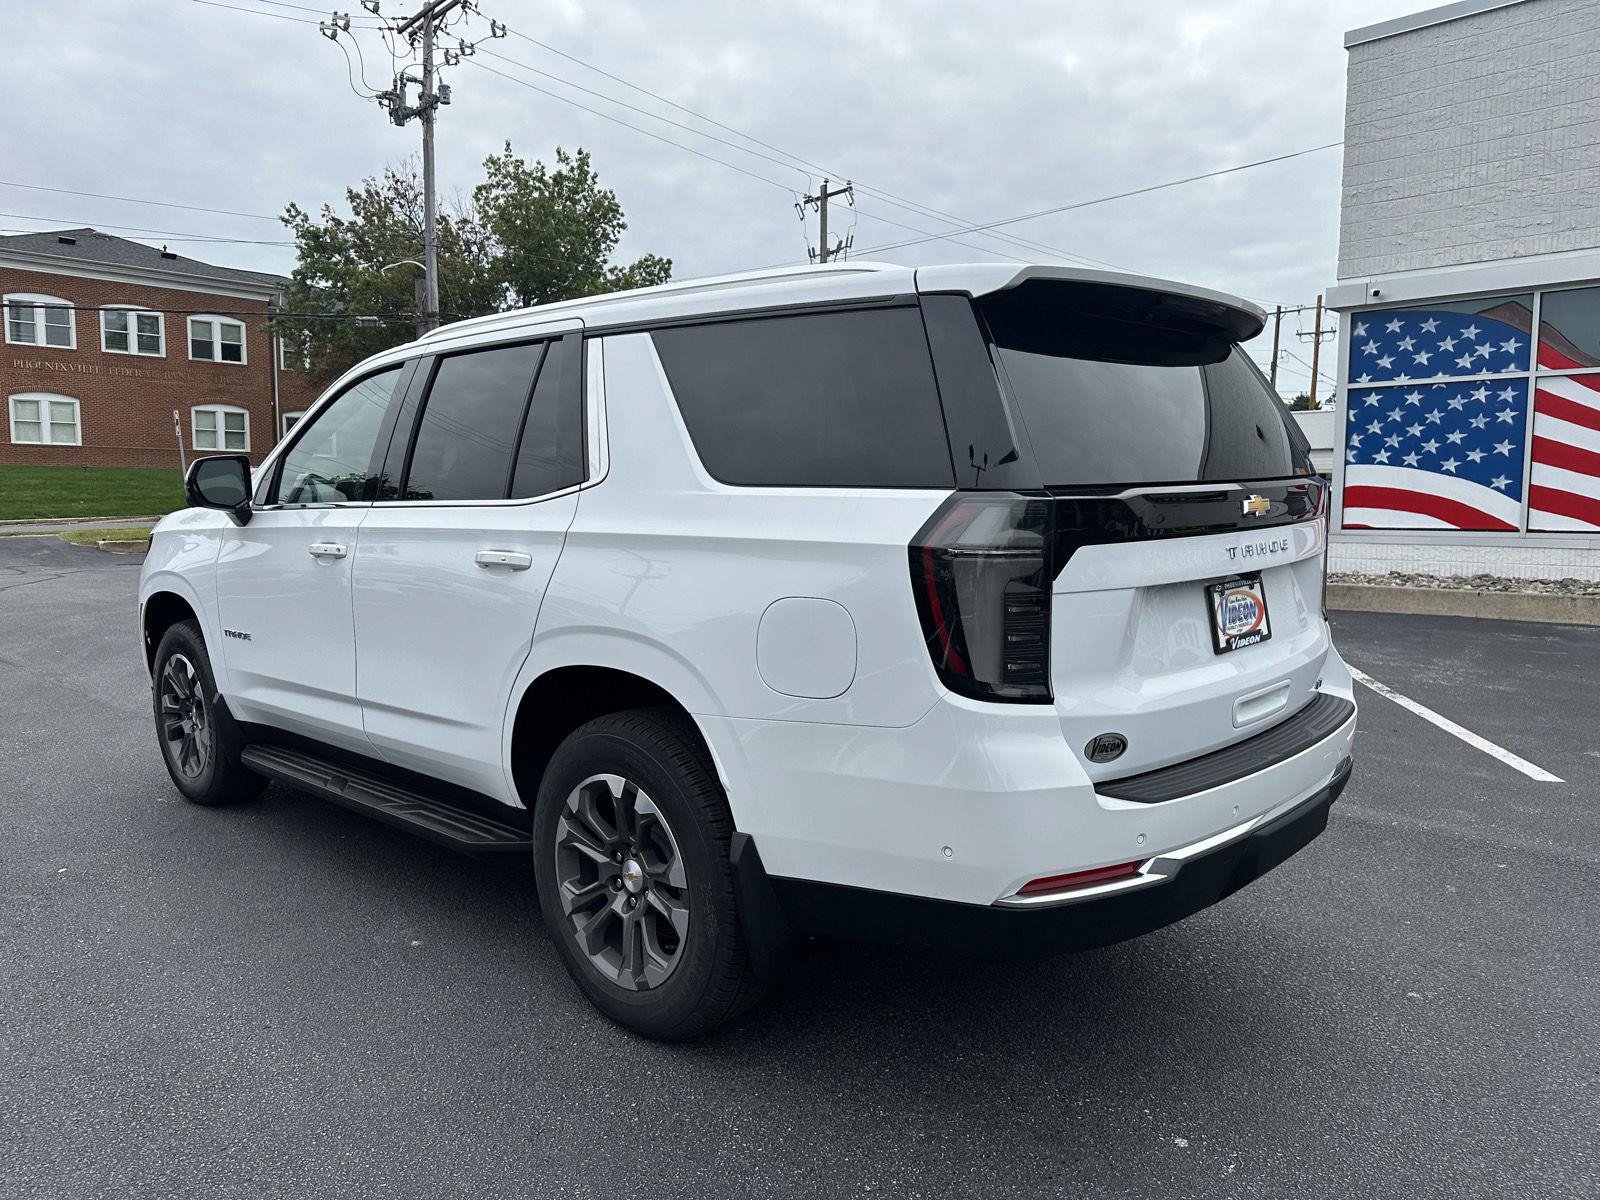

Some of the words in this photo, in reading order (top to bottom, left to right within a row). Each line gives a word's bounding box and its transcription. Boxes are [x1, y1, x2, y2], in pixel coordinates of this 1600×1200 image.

[1226, 539, 1288, 559] TAHOE
[1220, 595, 1257, 635] VIDEON
[223, 629, 252, 641] TAHOE
[1230, 635, 1261, 650] VIDEON
[1090, 737, 1122, 759] VIDEON
